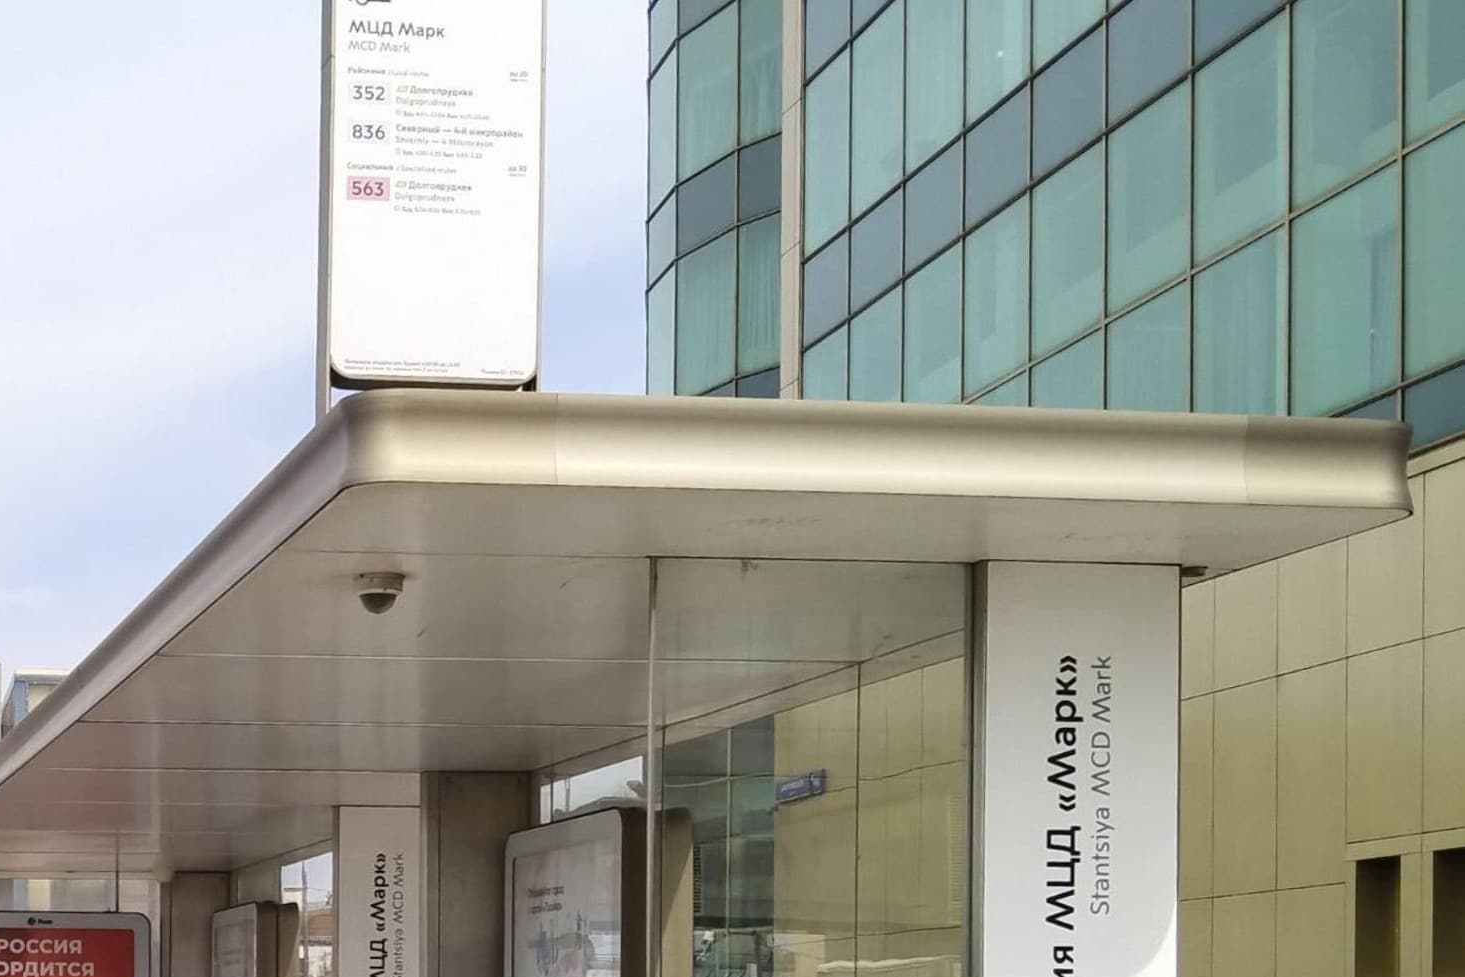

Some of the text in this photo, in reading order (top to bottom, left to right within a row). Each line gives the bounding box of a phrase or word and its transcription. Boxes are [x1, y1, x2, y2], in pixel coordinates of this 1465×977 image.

[348, 19, 445, 40] МЦД Марк
[348, 40, 410, 53] MCD Mark
[352, 85, 385, 101] 352
[352, 124, 386, 140] 836
[352, 181, 384, 197] 563
[1046, 655, 1084, 813] «Марк»
[1090, 655, 1115, 915] Stantsiya MCD Mark
[392, 852, 405, 886] Mark
[1045, 825, 1082, 931] МЦД
[370, 852, 389, 932] «Марк»
[392, 890, 405, 924] MCD
